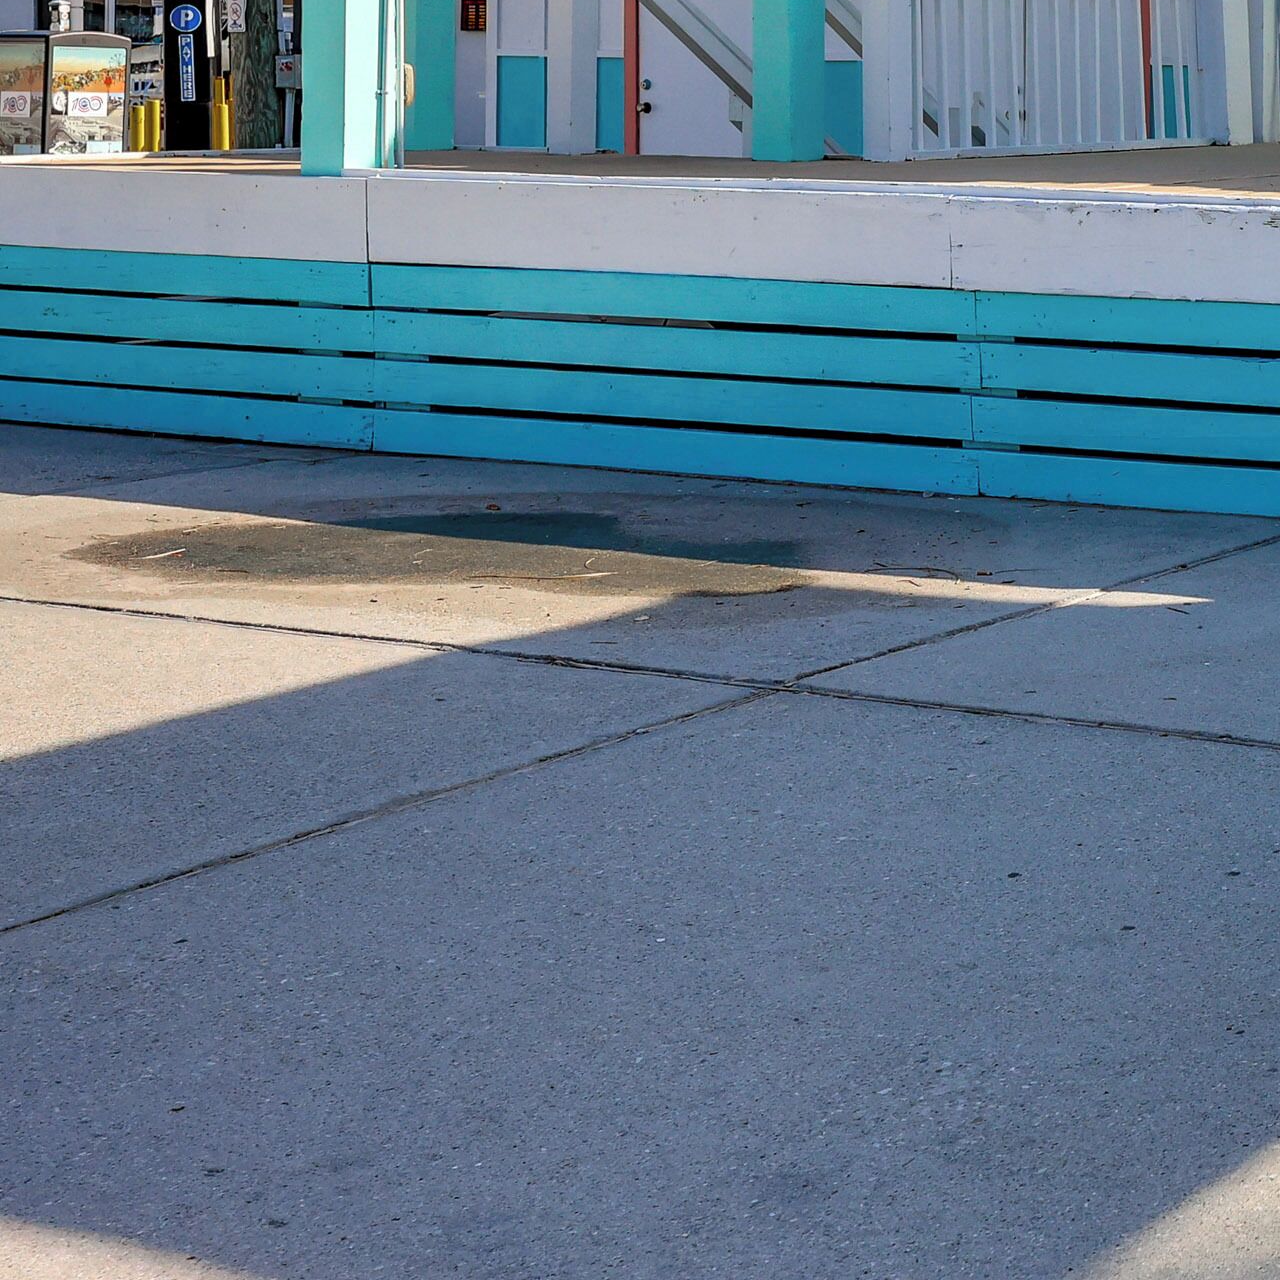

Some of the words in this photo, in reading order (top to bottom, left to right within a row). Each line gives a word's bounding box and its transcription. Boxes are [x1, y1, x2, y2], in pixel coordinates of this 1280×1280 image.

[180, 10, 194, 27] P
[181, 37, 191, 62] PAY
[182, 65, 193, 98] HERE
